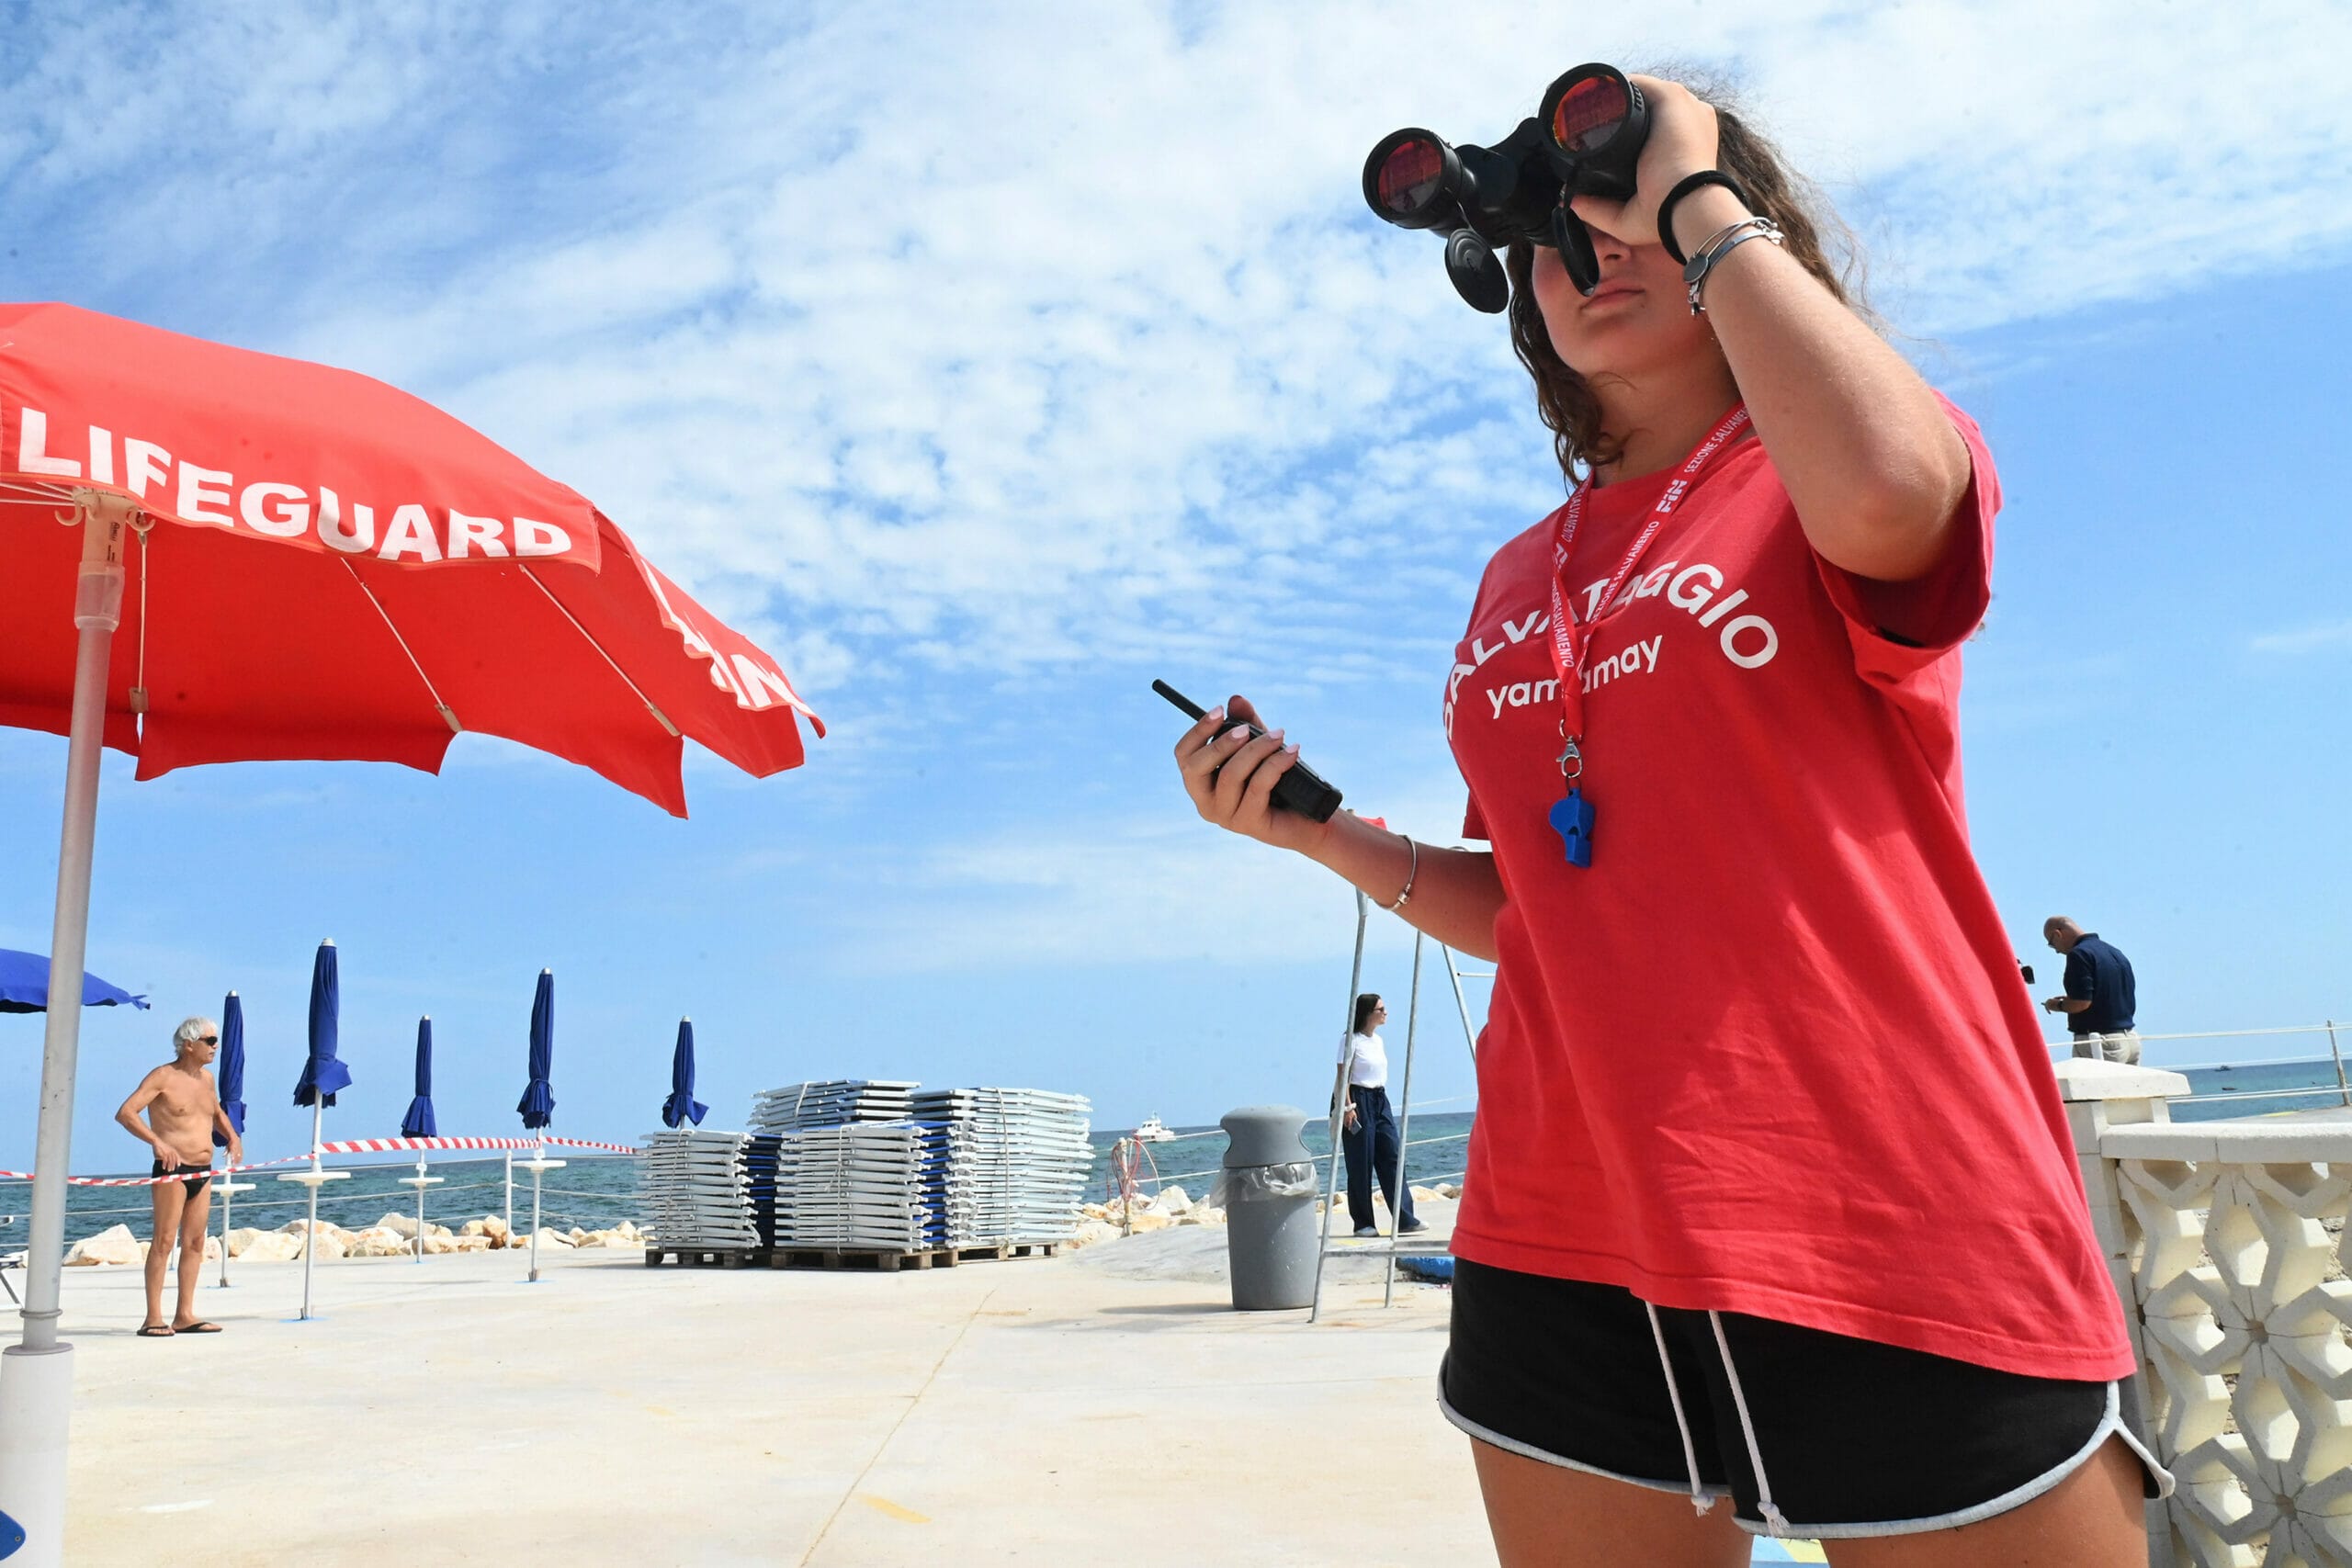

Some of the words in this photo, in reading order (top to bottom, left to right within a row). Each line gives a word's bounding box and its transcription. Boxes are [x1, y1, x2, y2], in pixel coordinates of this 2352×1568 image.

[17, 407, 572, 562] LIFEGUARD
[1613, 521, 1659, 581] SALVAMENTO
[1656, 479, 1688, 513] FIN
[1683, 441, 1718, 473] SEZIONE
